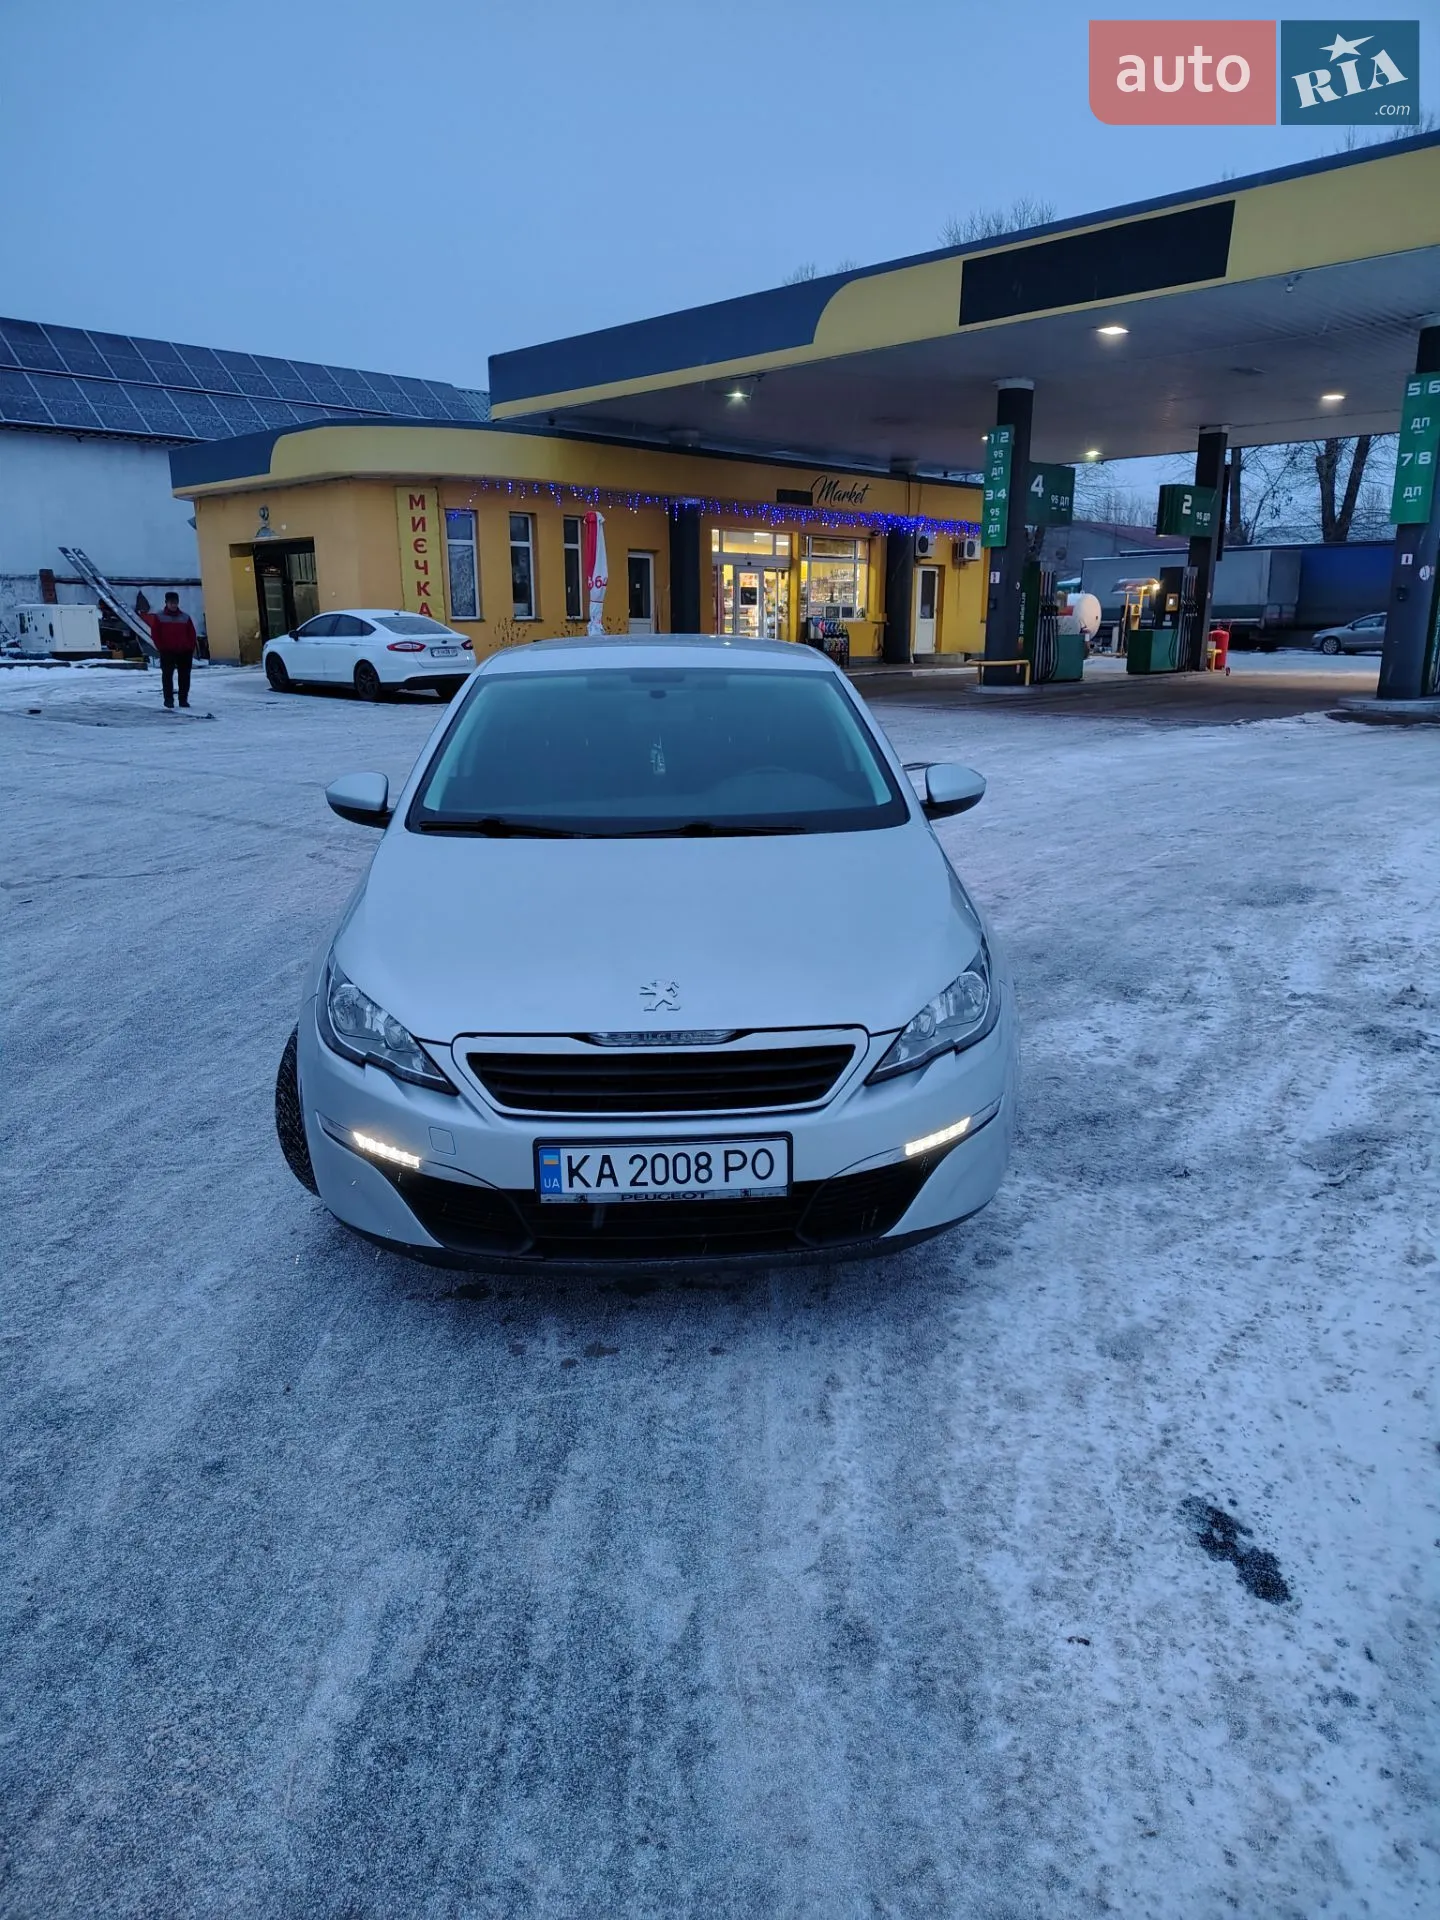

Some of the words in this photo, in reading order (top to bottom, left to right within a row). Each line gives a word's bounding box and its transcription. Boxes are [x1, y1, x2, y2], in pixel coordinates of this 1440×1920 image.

[1407, 383, 1421, 396] 5
[1410, 417, 1430, 430] ДП
[1000, 432, 1010, 443] 2
[993, 450, 1004, 458] 95
[1400, 453, 1413, 467] 7
[1418, 451, 1432, 465] 8
[991, 467, 1004, 477] ДП
[811, 475, 871, 507] Market
[1030, 474, 1044, 498] 4
[1403, 486, 1422, 499] ДП
[985, 490, 994, 501] 3
[997, 488, 1007, 499] 4
[1050, 494, 1059, 504] 95
[1059, 495, 1070, 507] ДП
[1182, 494, 1193, 515] 2
[989, 508, 1000, 516] 95
[987, 524, 1001, 534] ДП
[408, 493, 433, 618] МИЄЧКА
[566, 1154, 619, 1189] KA
[628, 1152, 713, 1187] 2008
[723, 1147, 775, 1183] PO
[543, 1178, 561, 1189] UA
[620, 1190, 708, 1202] PEUGEOT
